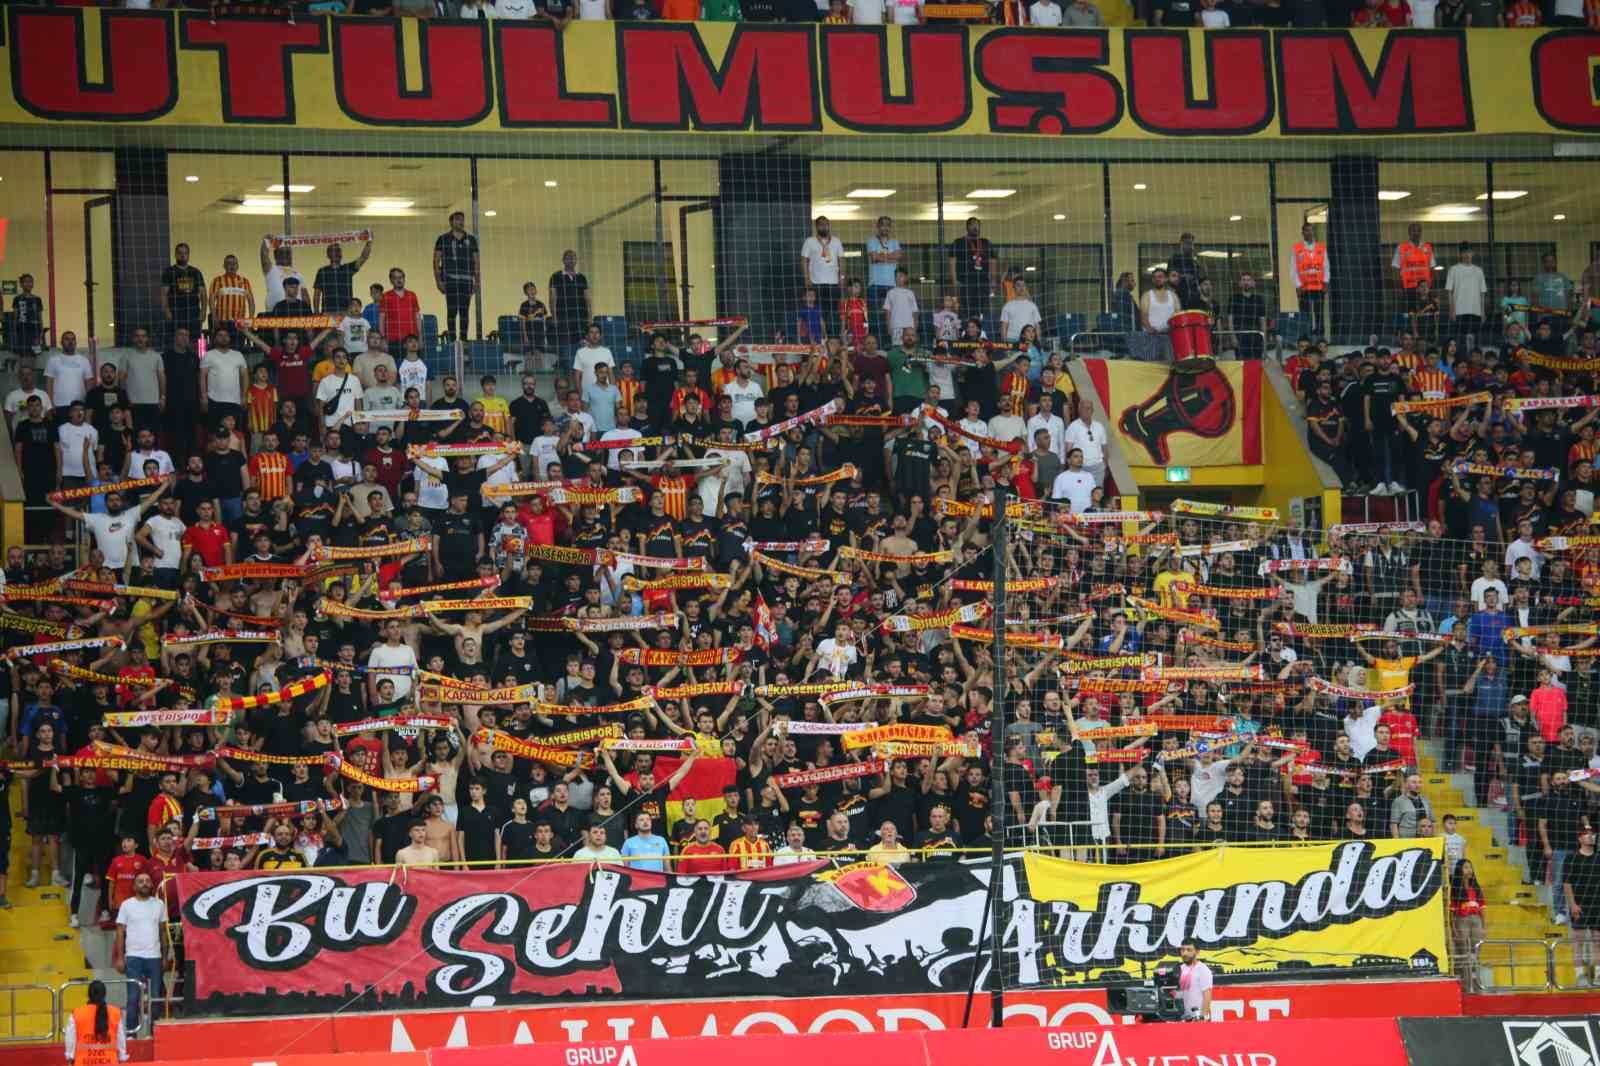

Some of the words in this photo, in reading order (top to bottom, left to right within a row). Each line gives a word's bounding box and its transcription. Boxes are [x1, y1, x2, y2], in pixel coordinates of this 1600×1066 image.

[0, 8, 1476, 135] UTULMUŞUM
[1076, 655, 1141, 672] KAYSERISPOR
[443, 688, 481, 702] KAPALI
[487, 687, 517, 701] KALE
[773, 683, 847, 695] KAYSERISPOR
[541, 726, 614, 746] KAYSERISPOR
[190, 874, 410, 966] Bu
[429, 870, 791, 1008] Şehir
[927, 841, 1437, 992] Arkanda
[1047, 1031, 1097, 1050] GRUP
[565, 1047, 617, 1066] GRUP
